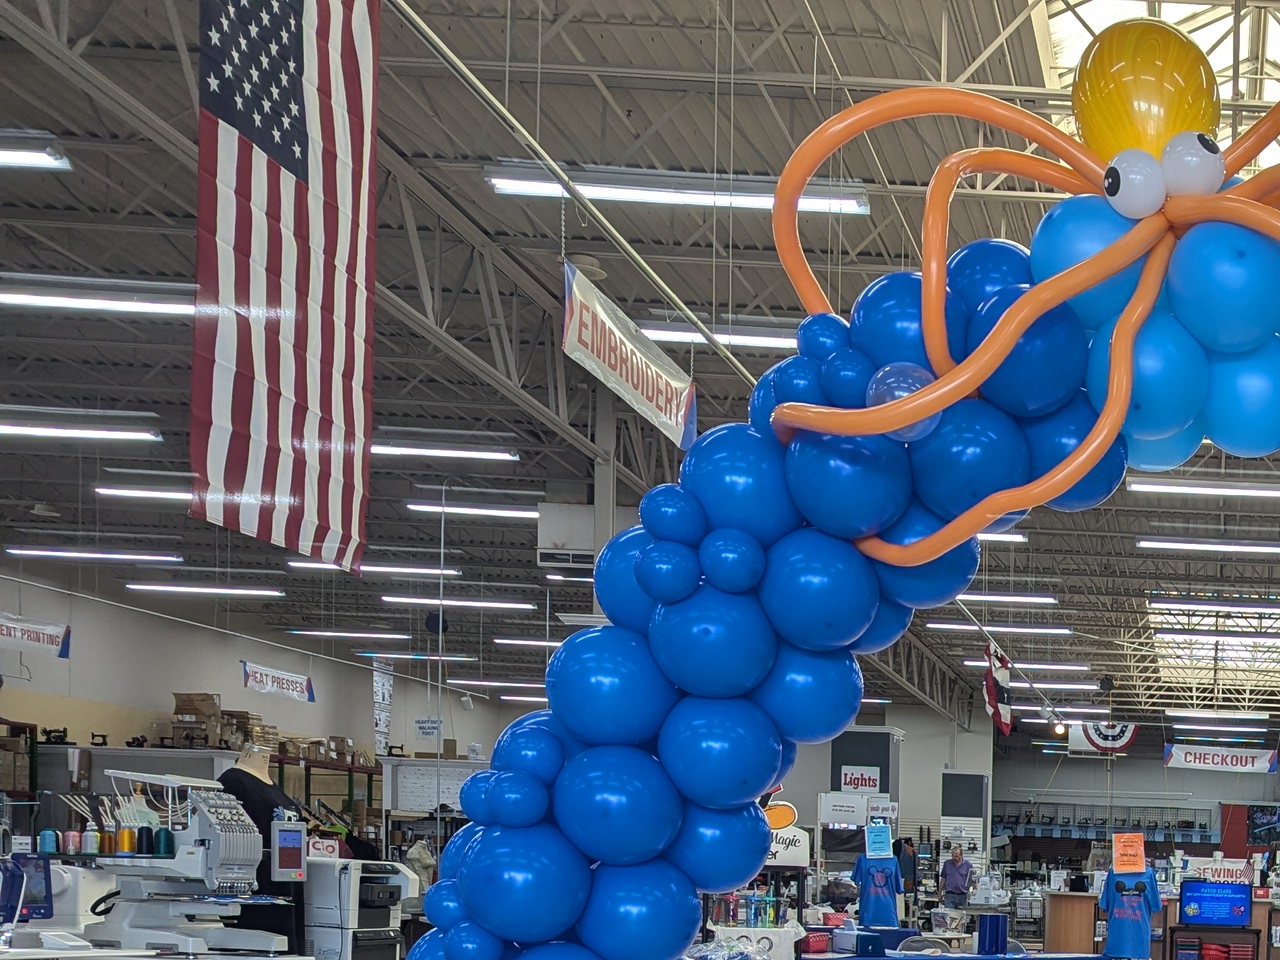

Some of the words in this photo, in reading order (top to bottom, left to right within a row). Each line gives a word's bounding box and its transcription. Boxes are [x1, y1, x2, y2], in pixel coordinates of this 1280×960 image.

[577, 299, 683, 427] EMBROIDERY
[20, 628, 60, 647] PRINTING
[249, 670, 269, 686] HEAT
[271, 676, 305, 694] PRESSES
[1184, 751, 1258, 768] CHECKOUT
[843, 772, 878, 790] Lights
